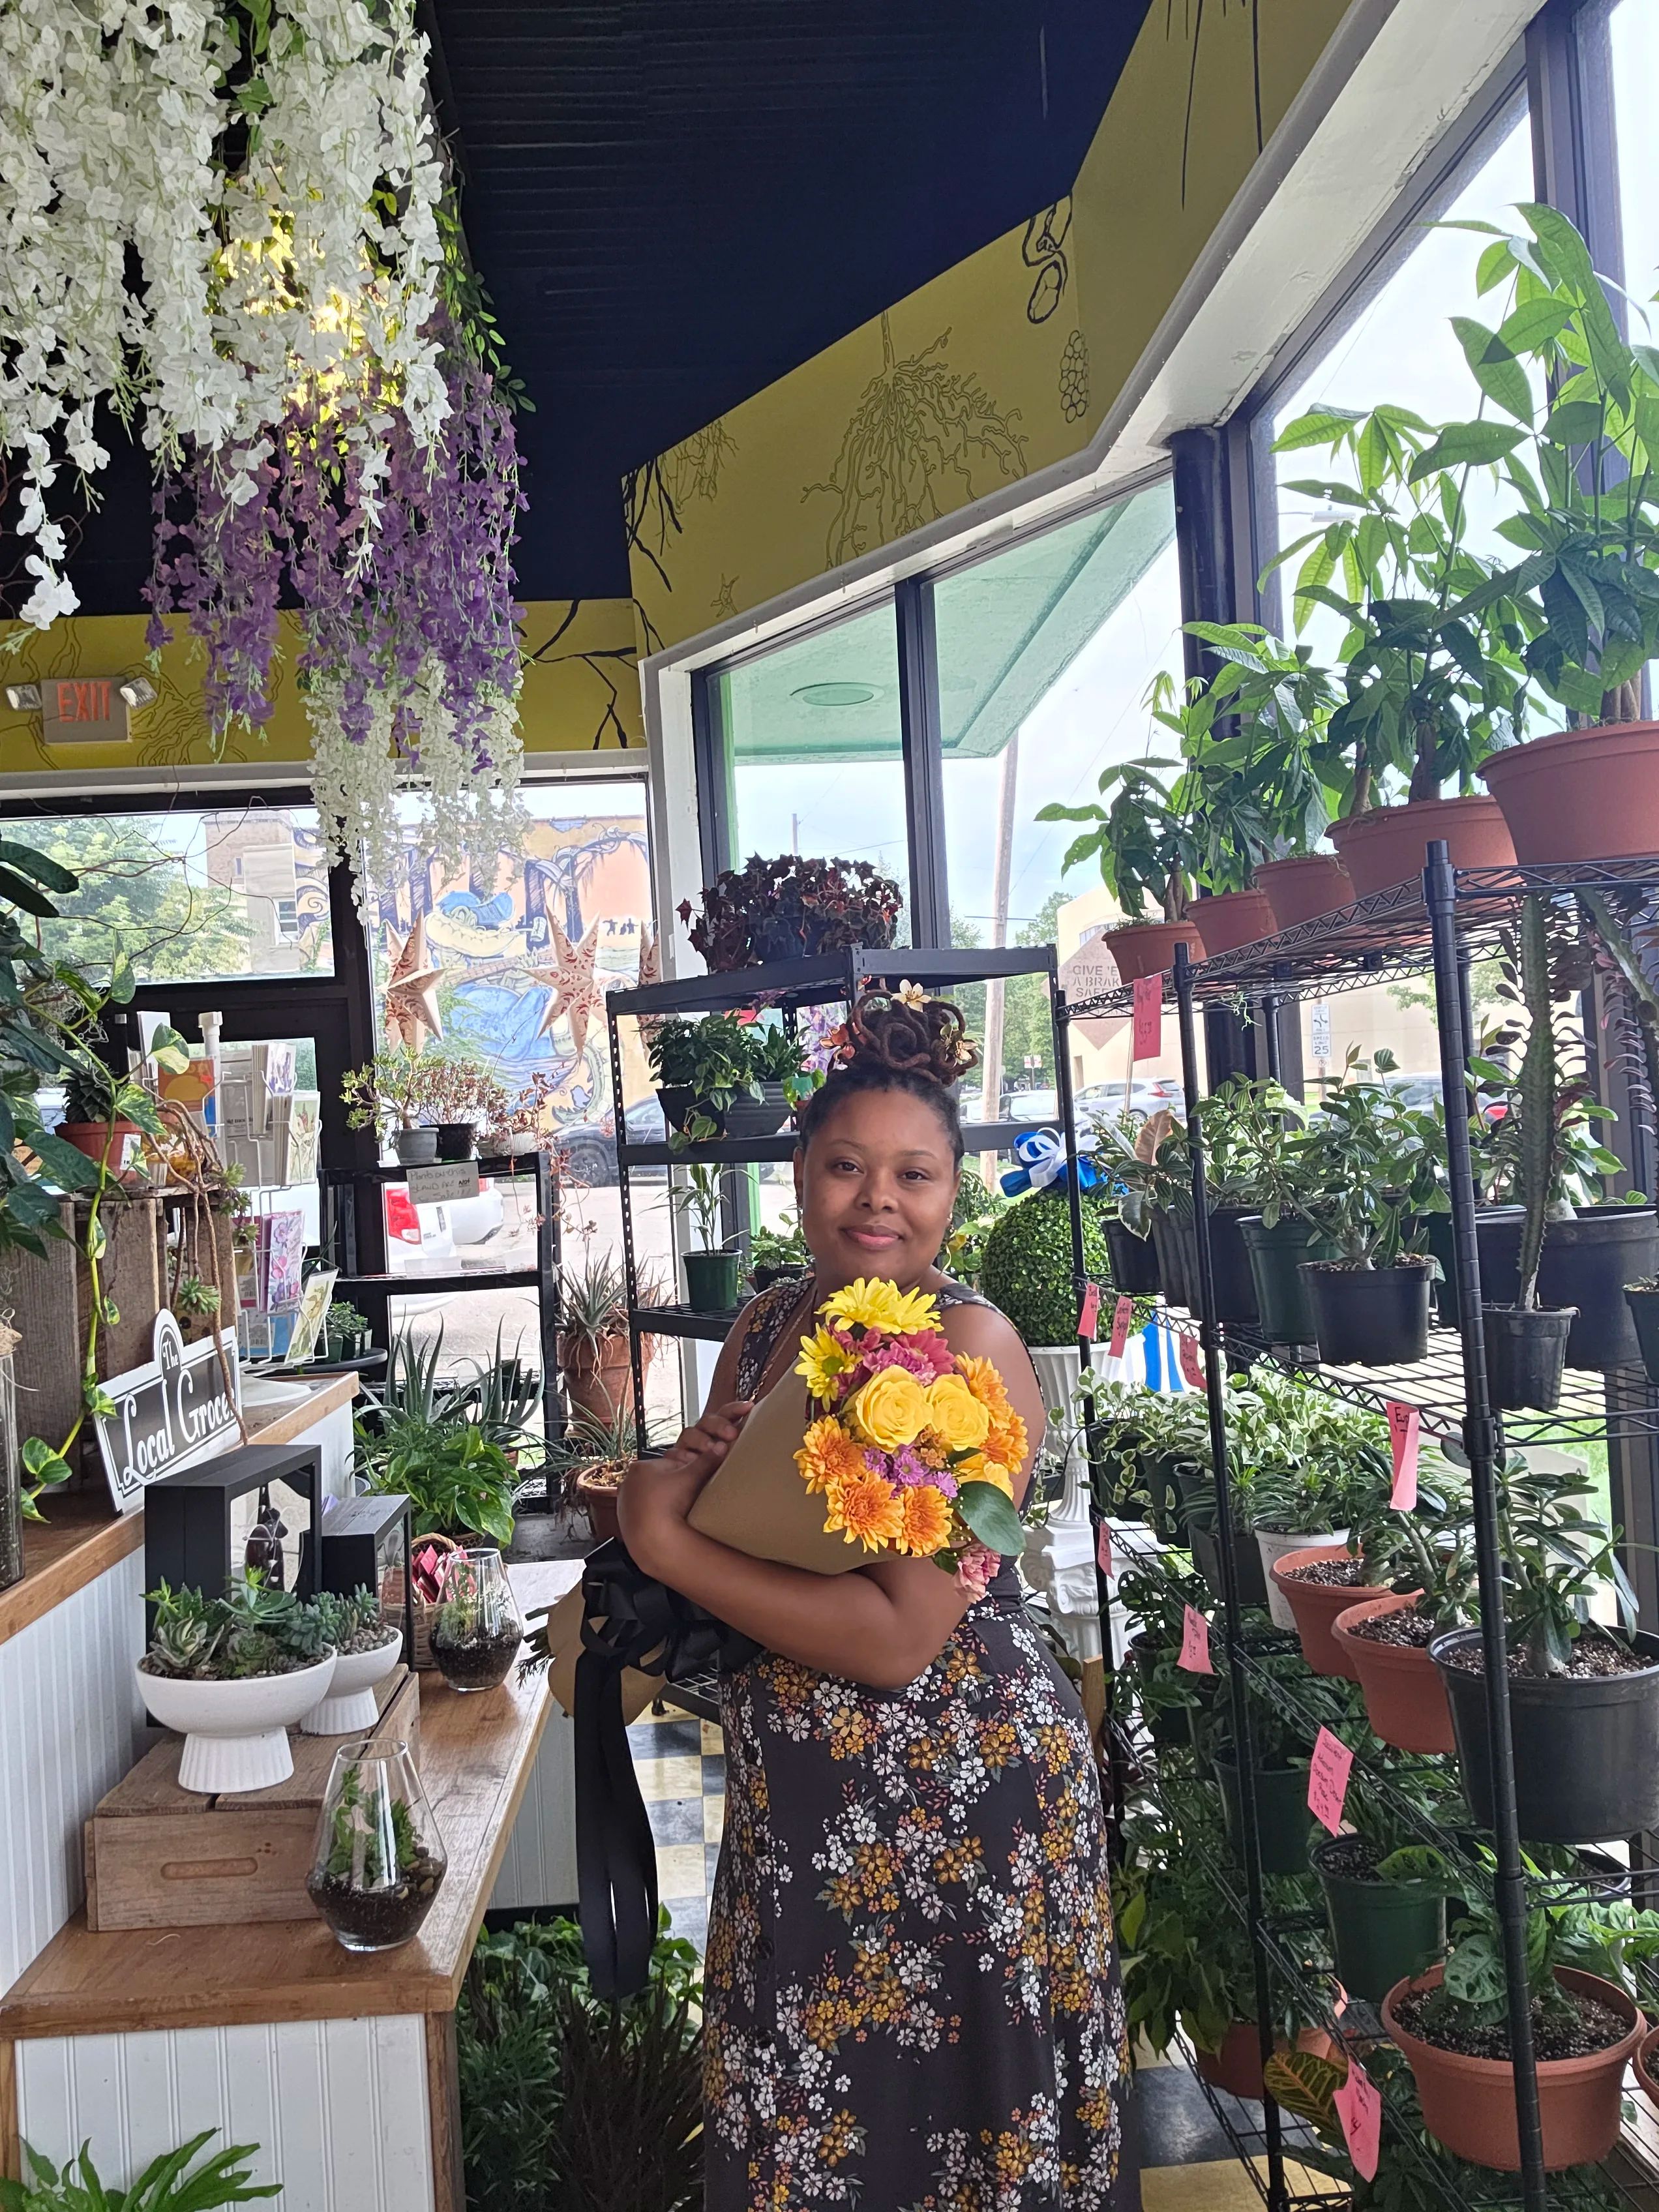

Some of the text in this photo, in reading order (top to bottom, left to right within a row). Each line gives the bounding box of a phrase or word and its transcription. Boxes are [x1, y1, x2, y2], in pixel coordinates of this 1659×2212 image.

[57, 681, 112, 723] EXIT
[1073, 965, 1118, 976] GIVE 'E
[1073, 977, 1120, 987] A BRAK
[1314, 1045, 1329, 1054] 25
[162, 1338, 179, 1370] The
[123, 1378, 175, 1487] Local
